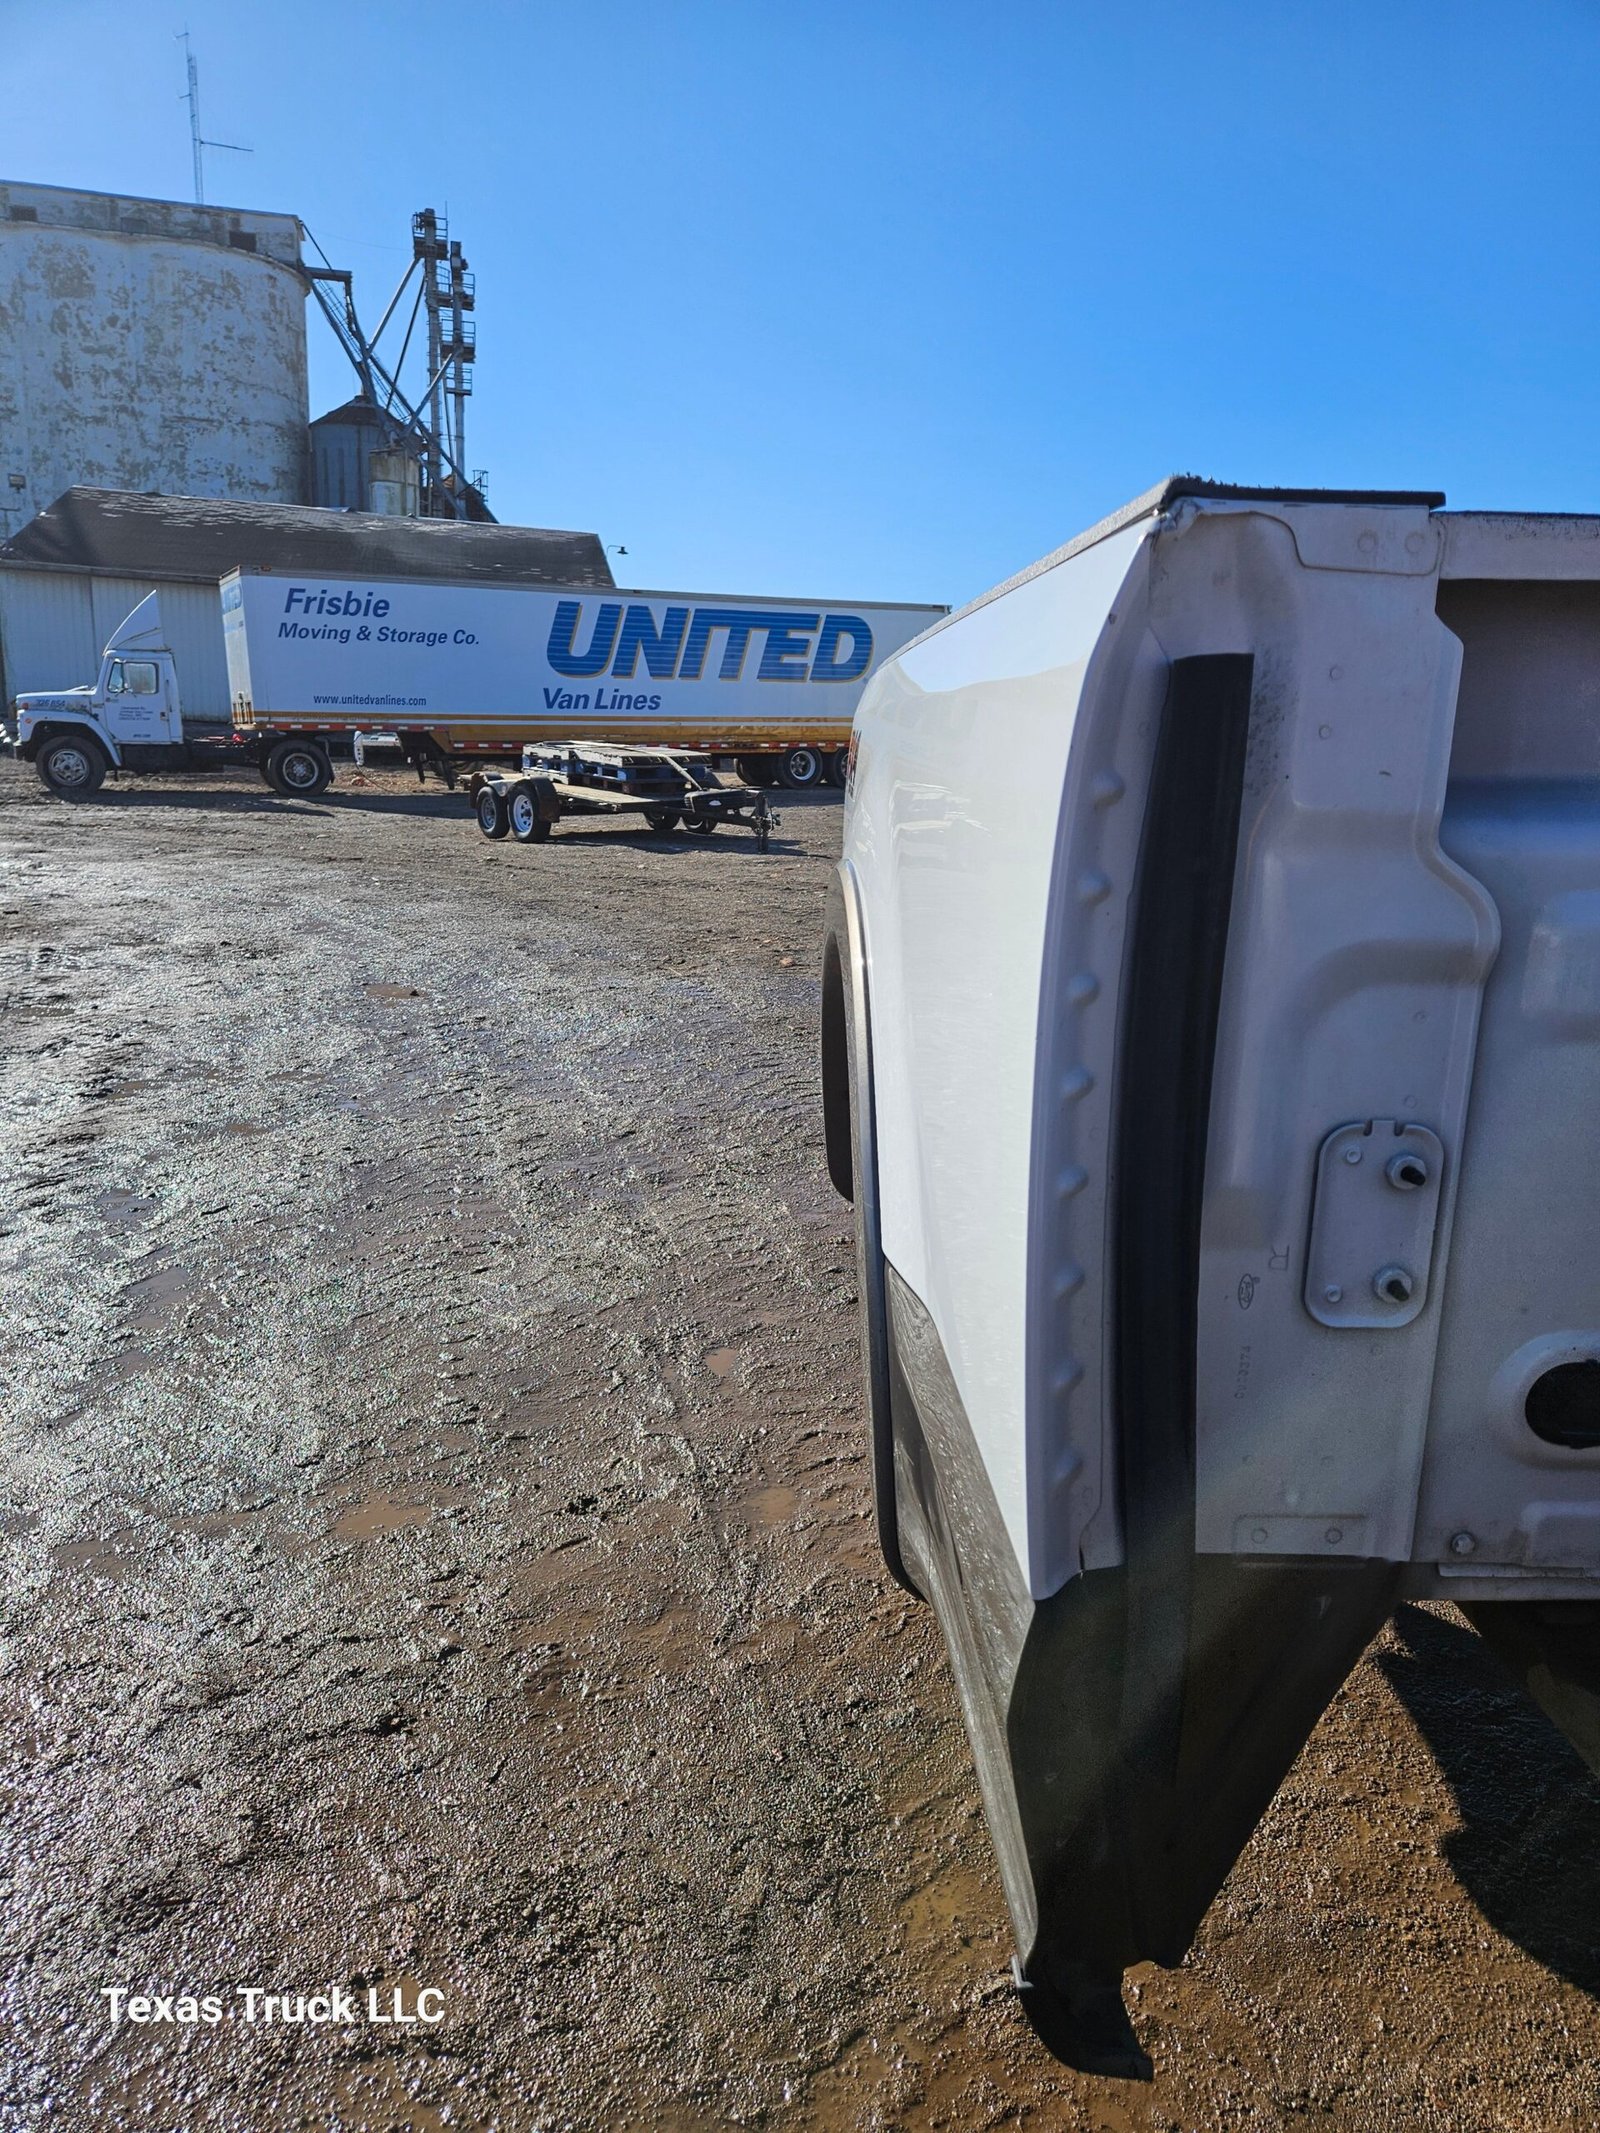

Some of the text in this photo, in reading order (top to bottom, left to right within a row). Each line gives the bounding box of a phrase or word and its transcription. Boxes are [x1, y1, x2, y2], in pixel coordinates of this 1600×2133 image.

[284, 587, 391, 618] Frisbie
[278, 622, 480, 647] Moving & Storage Co.
[546, 600, 874, 683] UNITED
[313, 694, 427, 707] www.unitedvanlines.com
[542, 687, 662, 710] Van Lines
